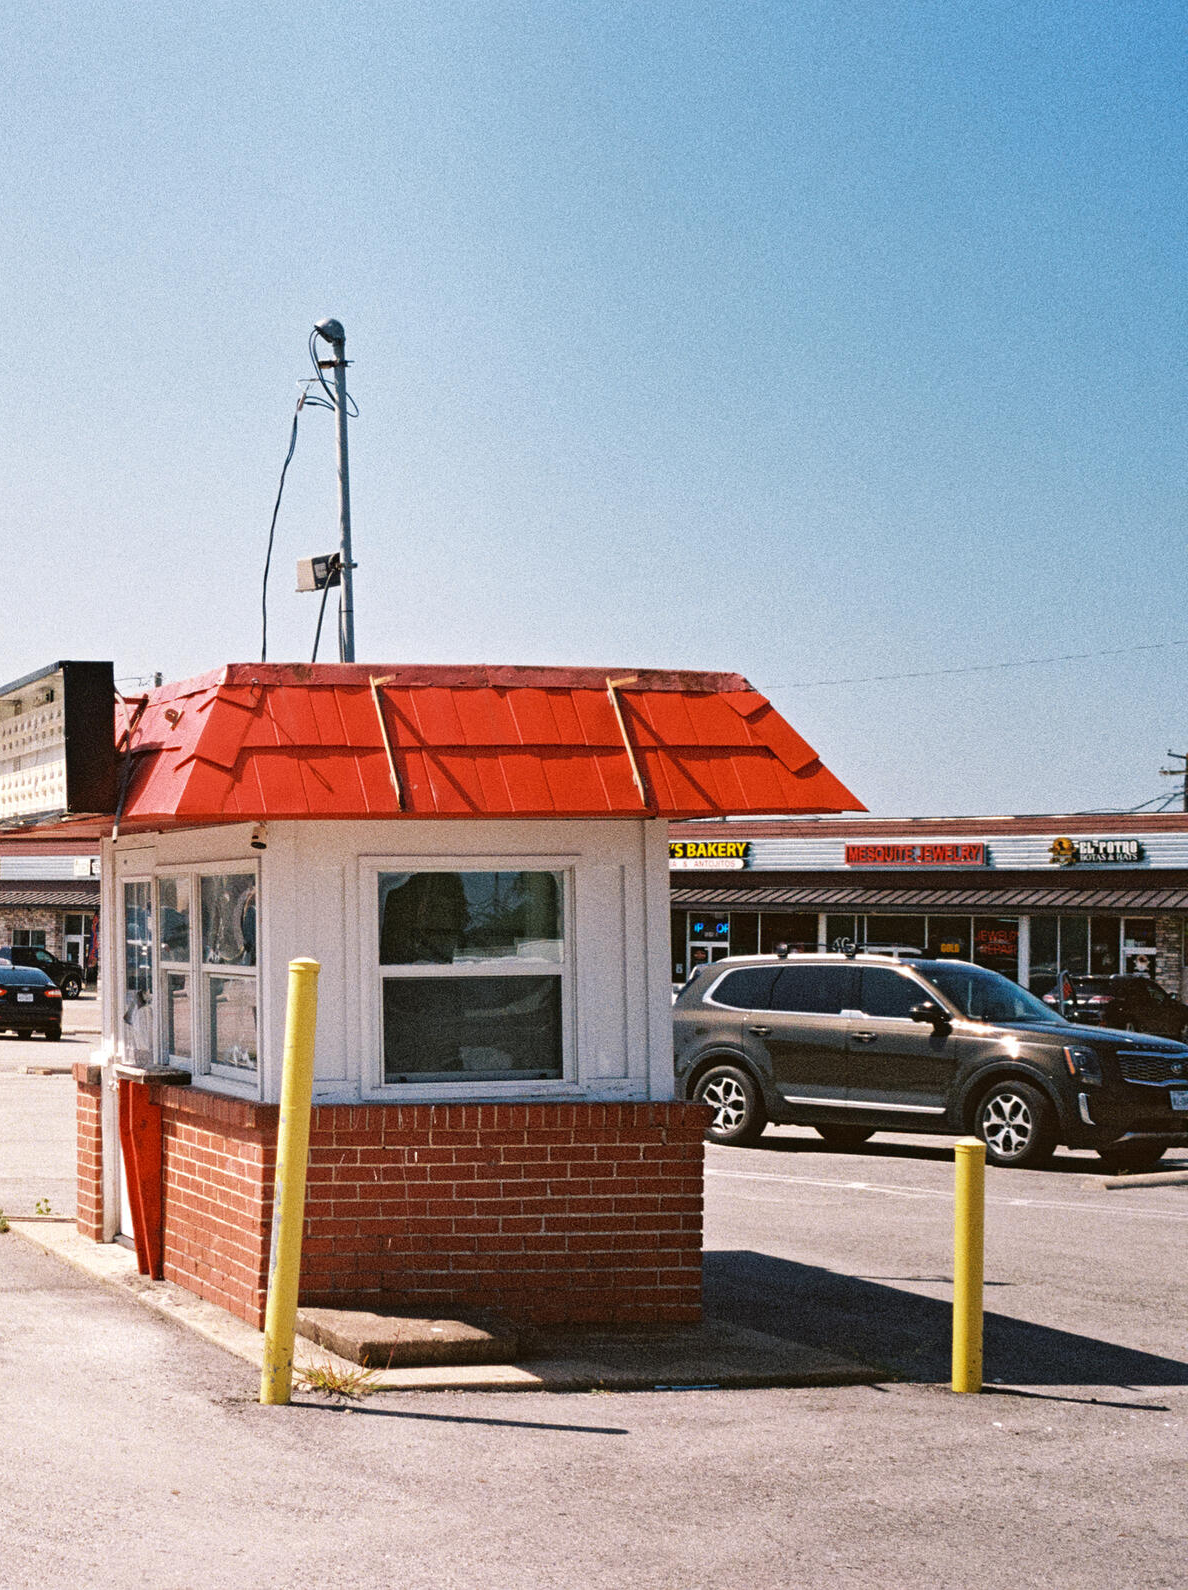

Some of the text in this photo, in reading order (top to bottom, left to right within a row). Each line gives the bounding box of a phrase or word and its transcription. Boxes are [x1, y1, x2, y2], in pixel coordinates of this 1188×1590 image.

[668, 843, 747, 857] 'S BAKERY
[848, 845, 978, 861] MESQUITE JEWELRY
[1079, 841, 1137, 855] EL POTRO
[1116, 853, 1138, 861] HATS
[694, 860, 736, 868] ANTOJITOS
[940, 943, 960, 953] GOLD
